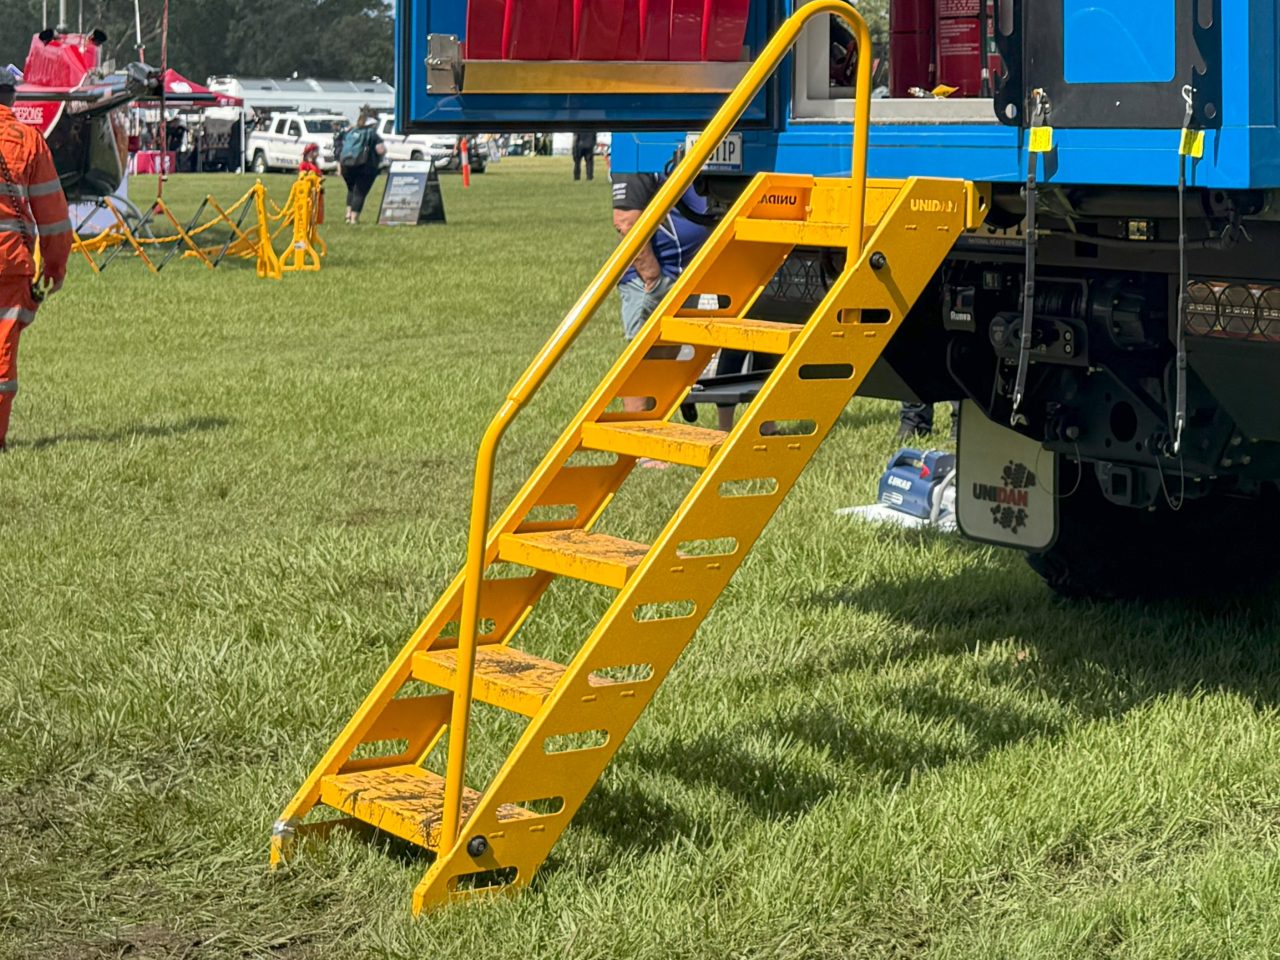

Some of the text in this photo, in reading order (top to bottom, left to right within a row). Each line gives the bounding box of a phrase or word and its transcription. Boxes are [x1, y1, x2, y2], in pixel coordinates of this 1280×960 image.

[910, 199, 958, 213] UNIDAN
[887, 475, 912, 491] LUKAS
[973, 483, 1028, 508] UNIDAN
